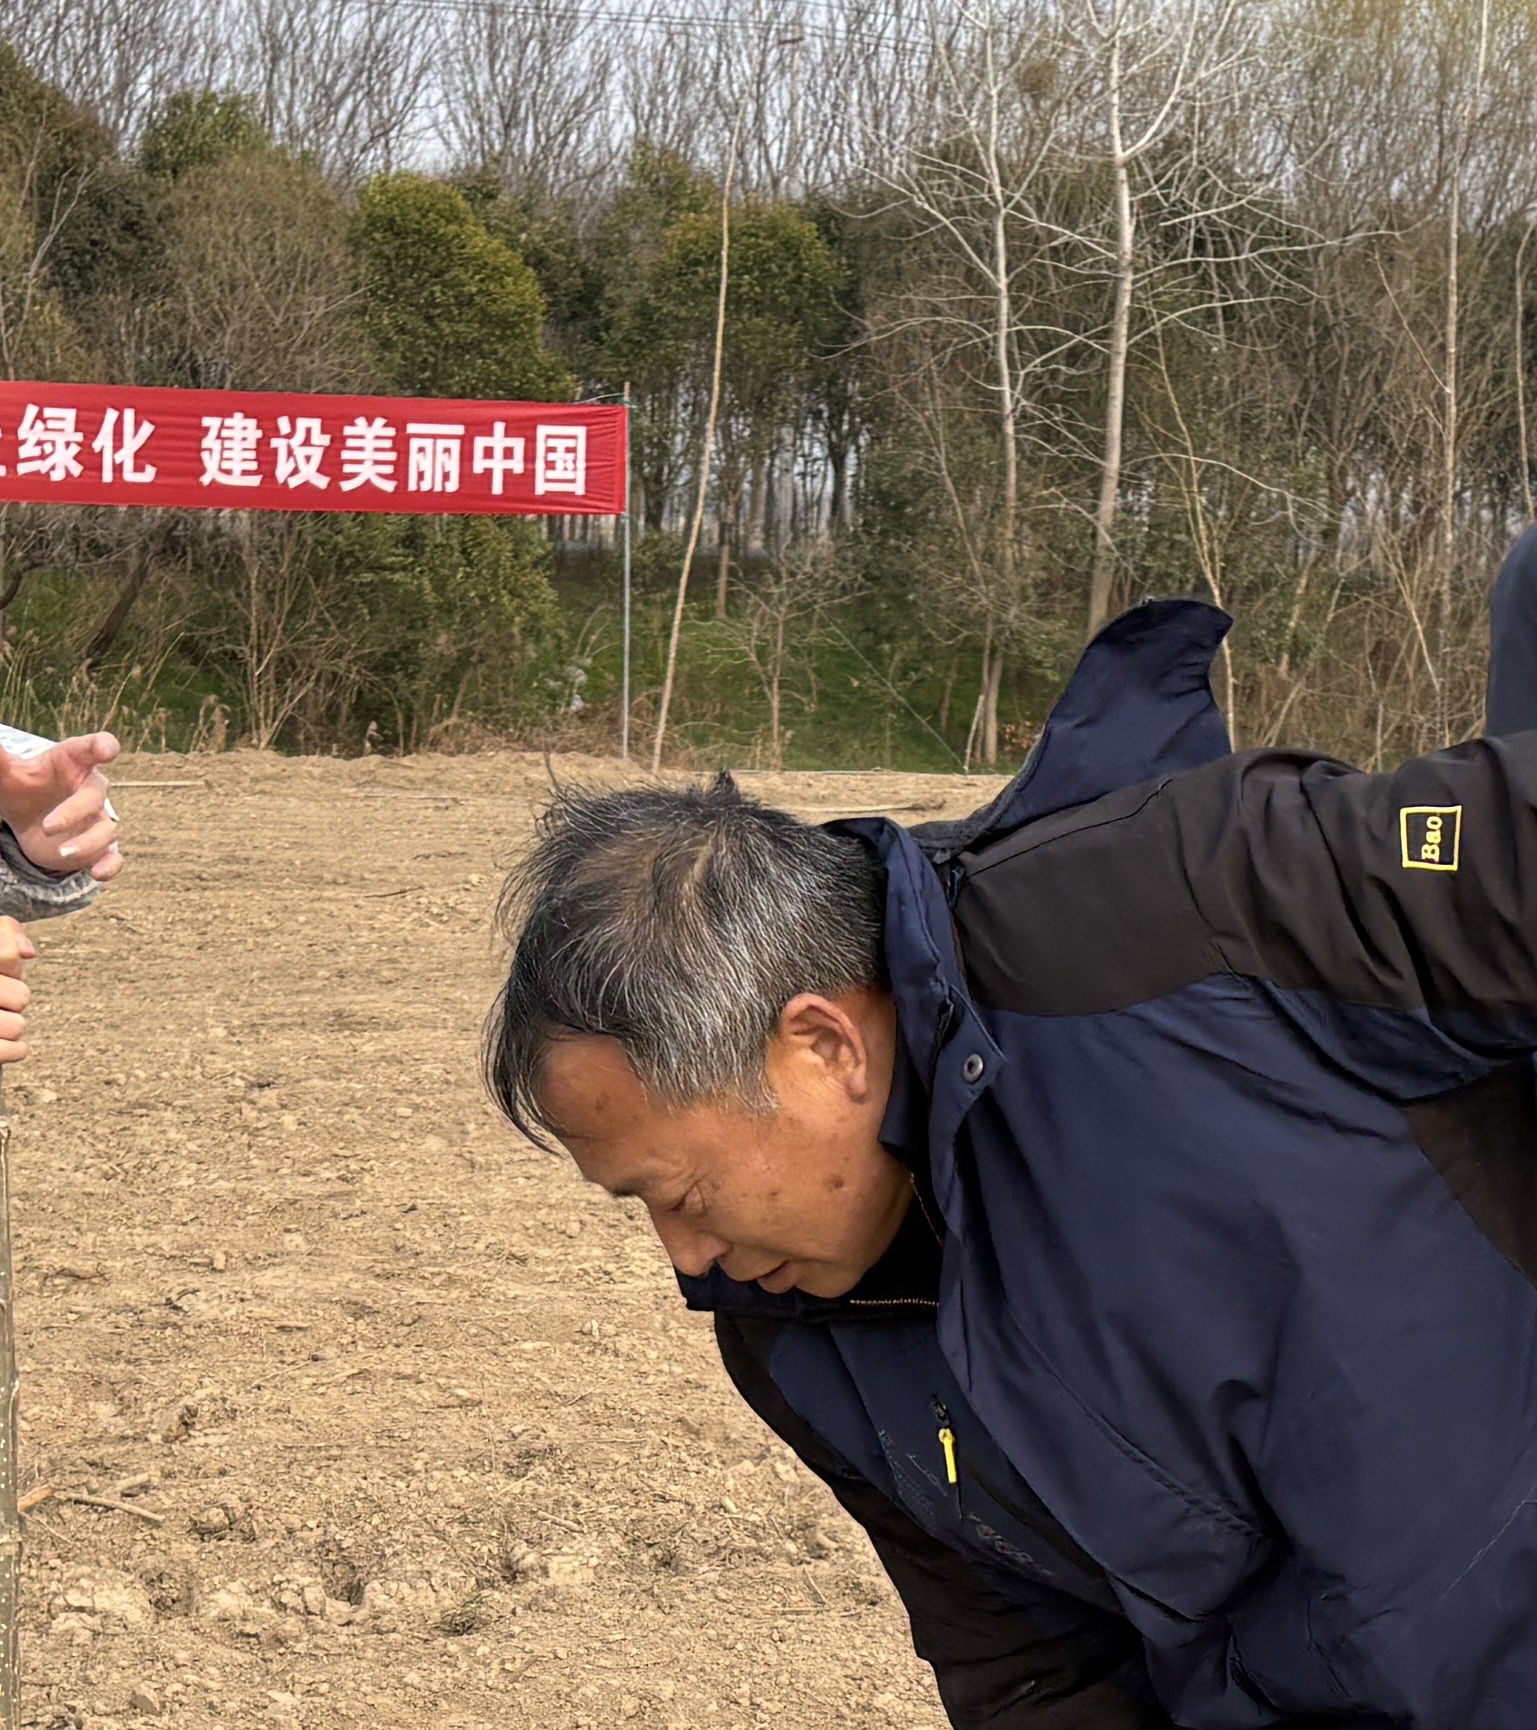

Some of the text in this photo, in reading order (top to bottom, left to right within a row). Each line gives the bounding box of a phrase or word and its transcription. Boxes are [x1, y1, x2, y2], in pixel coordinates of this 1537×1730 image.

[199, 412, 588, 496] 建设美丽中国
[1421, 815, 1443, 863] Bao
